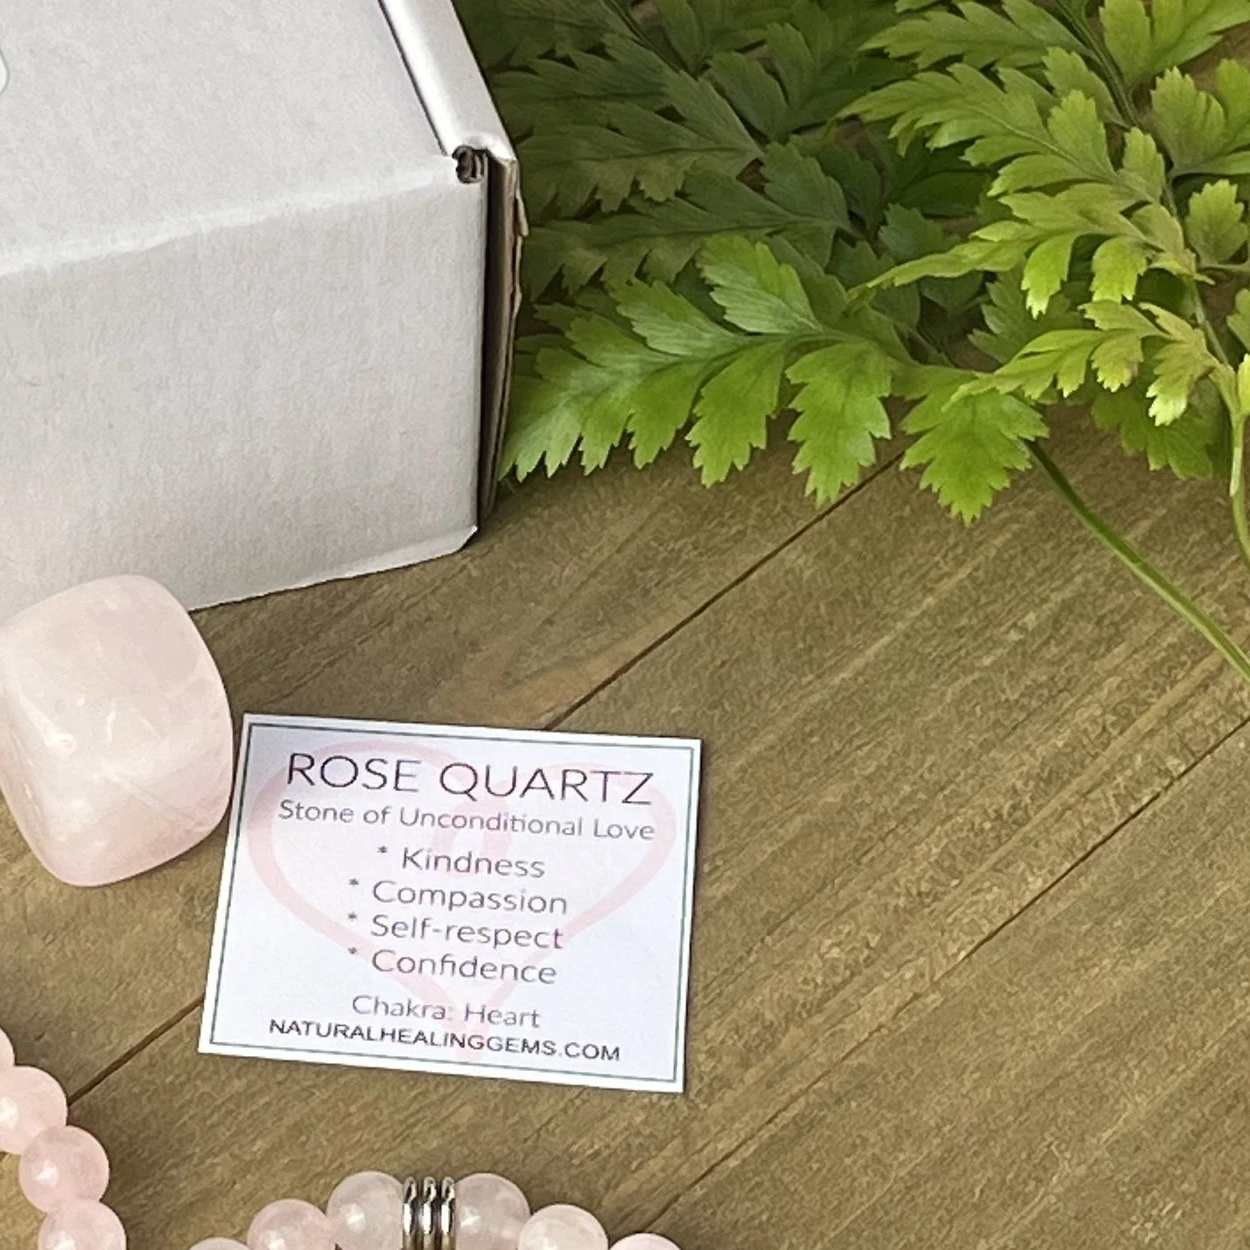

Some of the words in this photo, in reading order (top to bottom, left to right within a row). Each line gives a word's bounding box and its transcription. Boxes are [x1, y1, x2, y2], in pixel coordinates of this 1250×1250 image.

[286, 752, 421, 793] ROSE
[439, 762, 654, 806] QUARTZ
[278, 800, 354, 825] Stone
[363, 806, 392, 826] of
[399, 807, 583, 836] Unconditional
[593, 820, 655, 841] Love
[401, 847, 546, 879] Kindness
[372, 880, 568, 916] Compassion
[370, 915, 564, 950] Self-respect
[371, 949, 558, 985] Confidence
[351, 994, 453, 1023] Chakra:
[464, 1003, 541, 1029] Heart
[268, 1018, 621, 1061] NATURALHEALINGGEMS.COM
